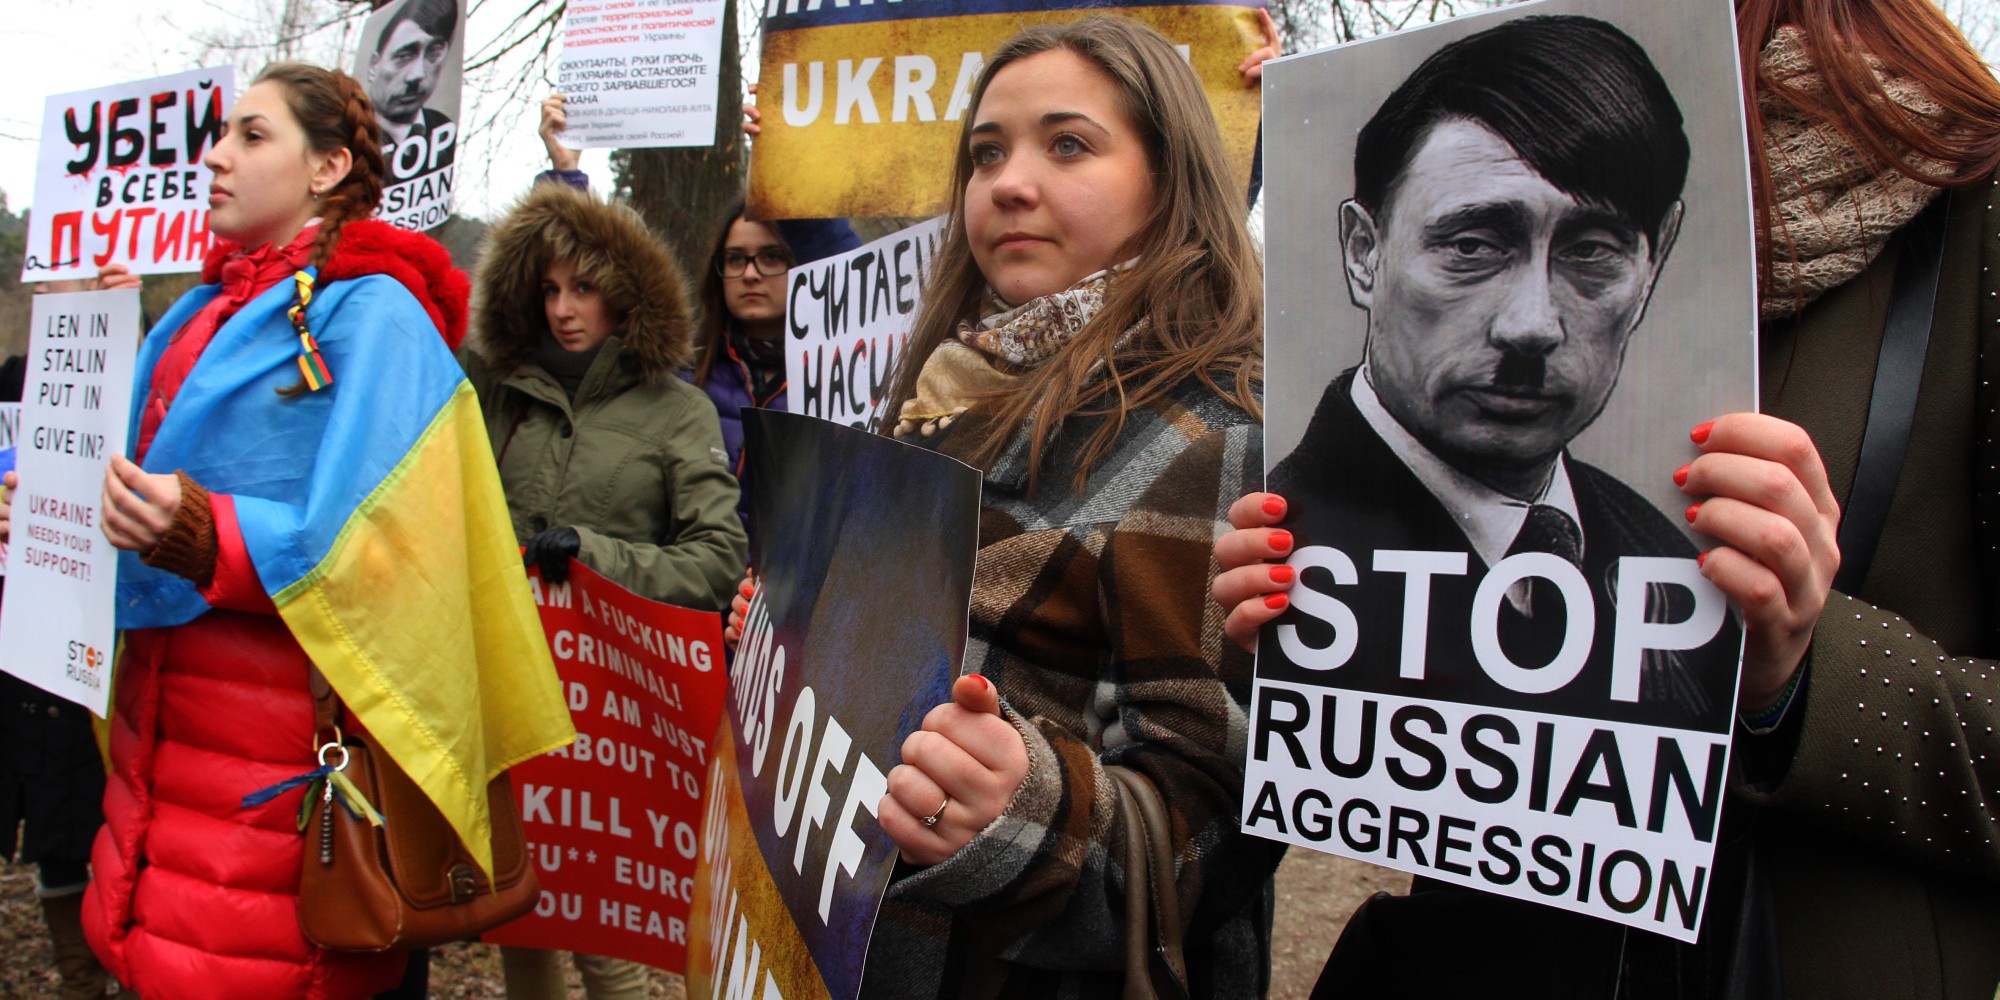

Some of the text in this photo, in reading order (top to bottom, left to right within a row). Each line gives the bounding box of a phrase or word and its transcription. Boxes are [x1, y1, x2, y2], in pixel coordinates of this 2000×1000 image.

[564, 25, 628, 37] целостности
[641, 17, 715, 30] политической
[567, 8, 694, 25] против территориальной
[564, 35, 640, 47] независимости
[558, 65, 708, 83] ОТ УКРАИНЫ ОСТАНОВИТЕ
[631, 55, 661, 66] РУКИ
[663, 53, 703, 64] ПРОЧЬ
[557, 77, 697, 94] СВОЕГО ЗАРВАВШЕГОСЯ
[566, 94, 599, 105] ХАНА
[64, 79, 223, 175] УБЕЙ
[121, 170, 197, 204] СЕБЕ
[47, 313, 109, 338] LEN IN
[43, 348, 106, 374] STALIN
[38, 382, 102, 411] PUT IN
[34, 426, 76, 455] GIVE
[80, 432, 105, 460] IN?
[29, 494, 93, 528] UKRAINE
[27, 523, 92, 554] NEEDS YOUR
[25, 546, 92, 582] SUPPORT!
[582, 589, 597, 619] A
[599, 598, 713, 673] FUCKING
[1276, 545, 1727, 704] STOP
[66, 663, 101, 693] RUSSIA
[553, 629, 683, 712] CRIMINAL!
[602, 690, 642, 728] AM
[652, 711, 707, 766] JUST
[666, 760, 700, 800] TO
[1253, 686, 1727, 845] RUSSIAN
[522, 783, 633, 839] KILL
[774, 685, 888, 928] OFF
[1245, 780, 1707, 932] AGGRESSION
[533, 890, 583, 921] OU
